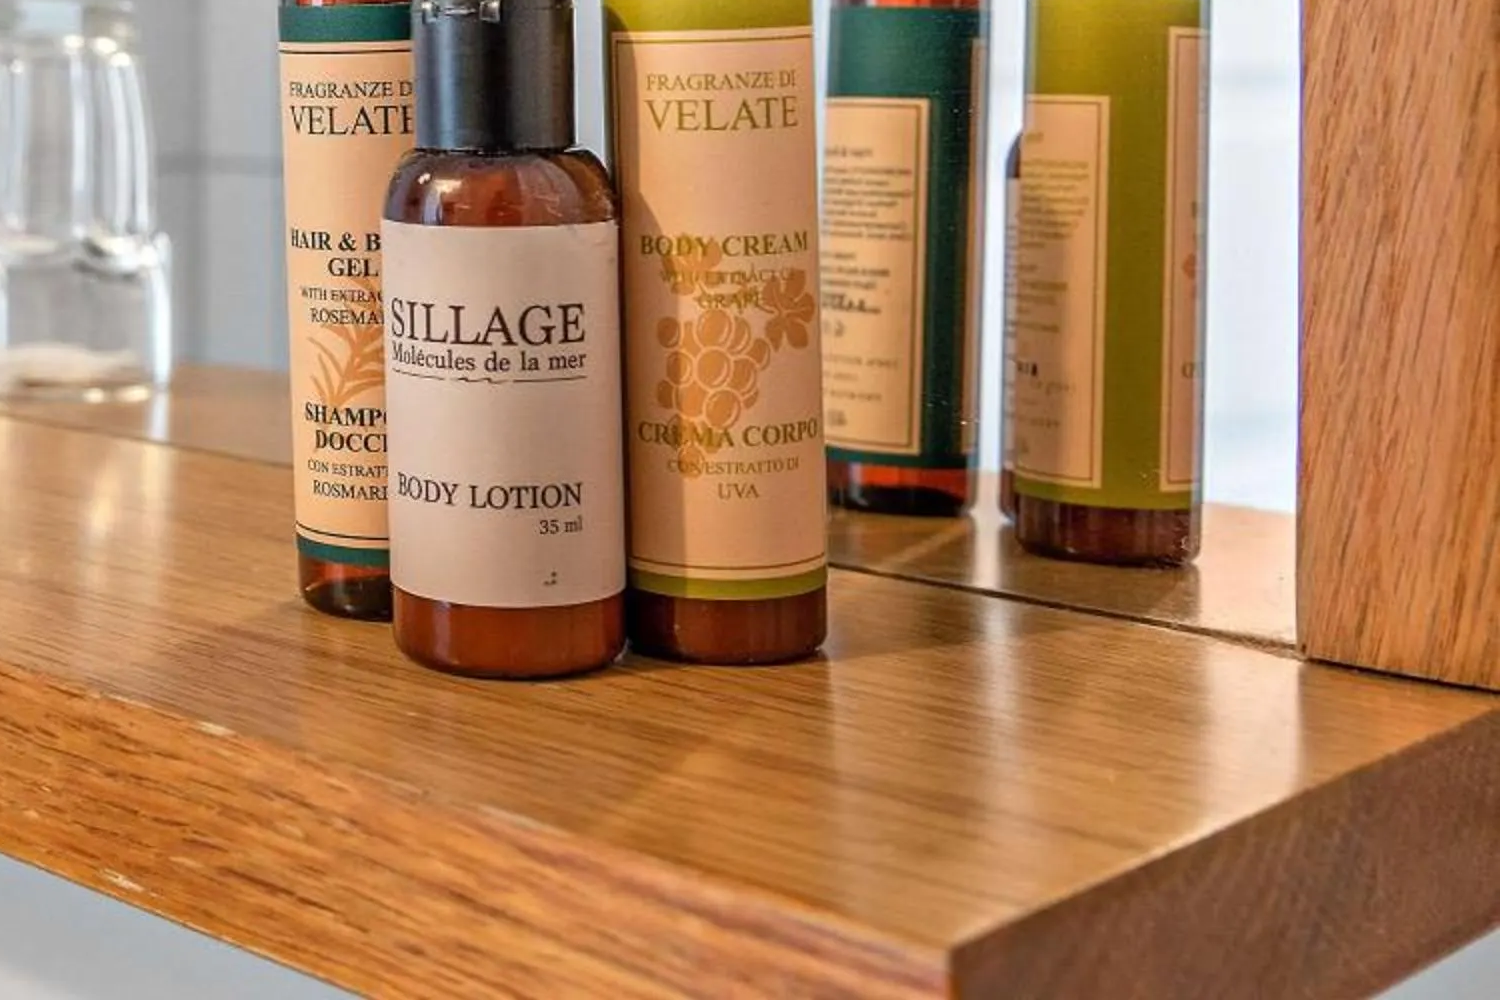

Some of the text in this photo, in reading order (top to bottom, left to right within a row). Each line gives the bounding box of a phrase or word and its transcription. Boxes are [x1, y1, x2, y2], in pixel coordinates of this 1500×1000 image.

[289, 81, 414, 99] FRAGRANZE D
[646, 69, 796, 91] FRAGRANZE DI
[645, 96, 799, 132] VELATE
[291, 228, 332, 251] HAIR
[338, 231, 357, 251] &
[640, 235, 713, 257] BODY
[722, 231, 808, 258] CREAM
[327, 257, 379, 277] GEL
[331, 289, 383, 303] EXTRA
[310, 308, 384, 325] ROSEMA
[391, 297, 586, 347] SILLAGE
[392, 341, 587, 373] Molécules de la mer
[305, 401, 387, 427] SHAMP
[315, 429, 388, 453] DOCCI
[742, 418, 818, 447] CORPO
[331, 463, 388, 478] ESTRATT
[705, 459, 785, 476] ESTRATTO
[313, 479, 388, 501] ROSMARI
[398, 472, 583, 510] BODY LOTION
[717, 482, 760, 500] UVA
[539, 515, 583, 535] 35 ml
